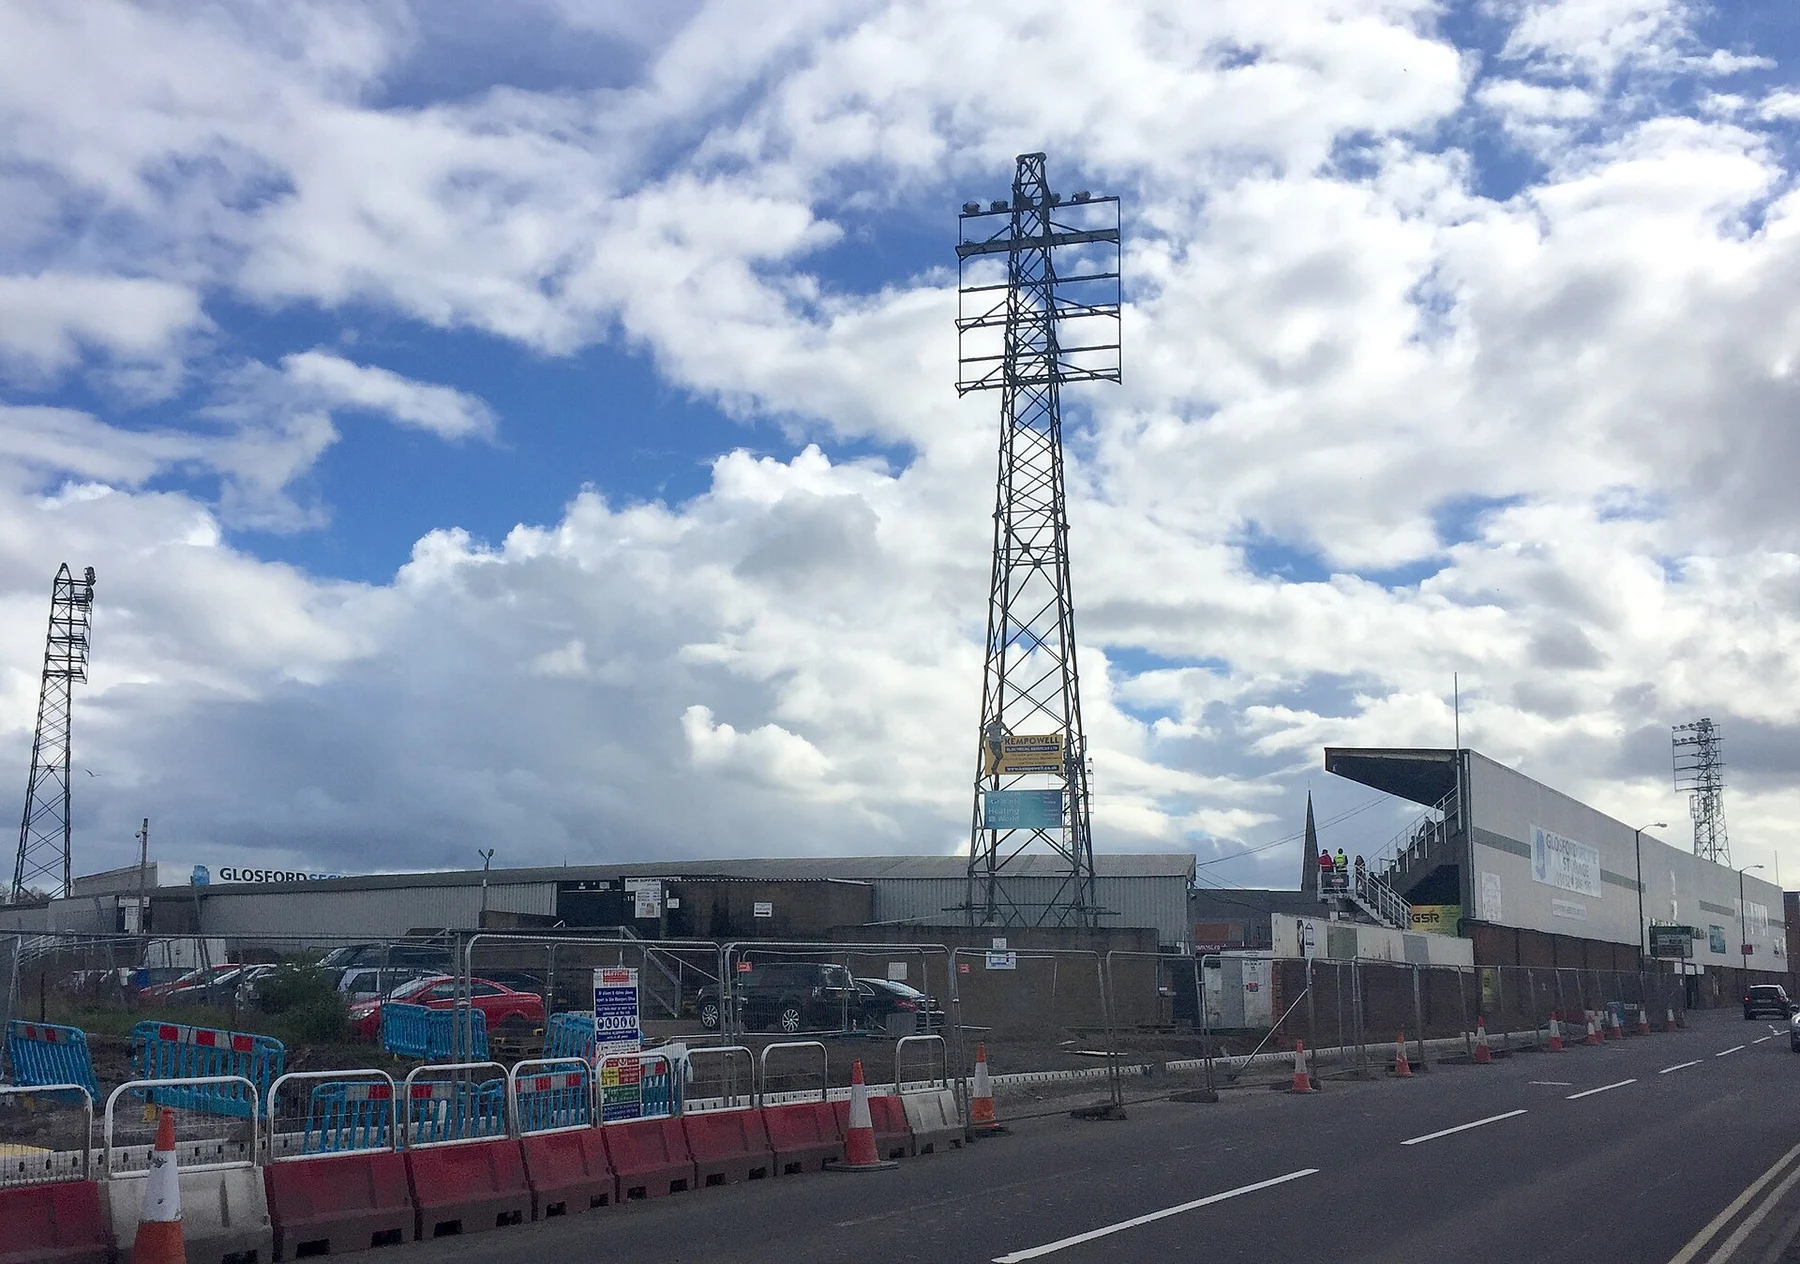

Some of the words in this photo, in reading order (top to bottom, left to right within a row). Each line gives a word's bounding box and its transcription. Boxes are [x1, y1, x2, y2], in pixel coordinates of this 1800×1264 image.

[1004, 737, 1060, 745] KEMPOWELL
[220, 868, 307, 882] GLOSFORD
[1411, 912, 1440, 923] GSR
